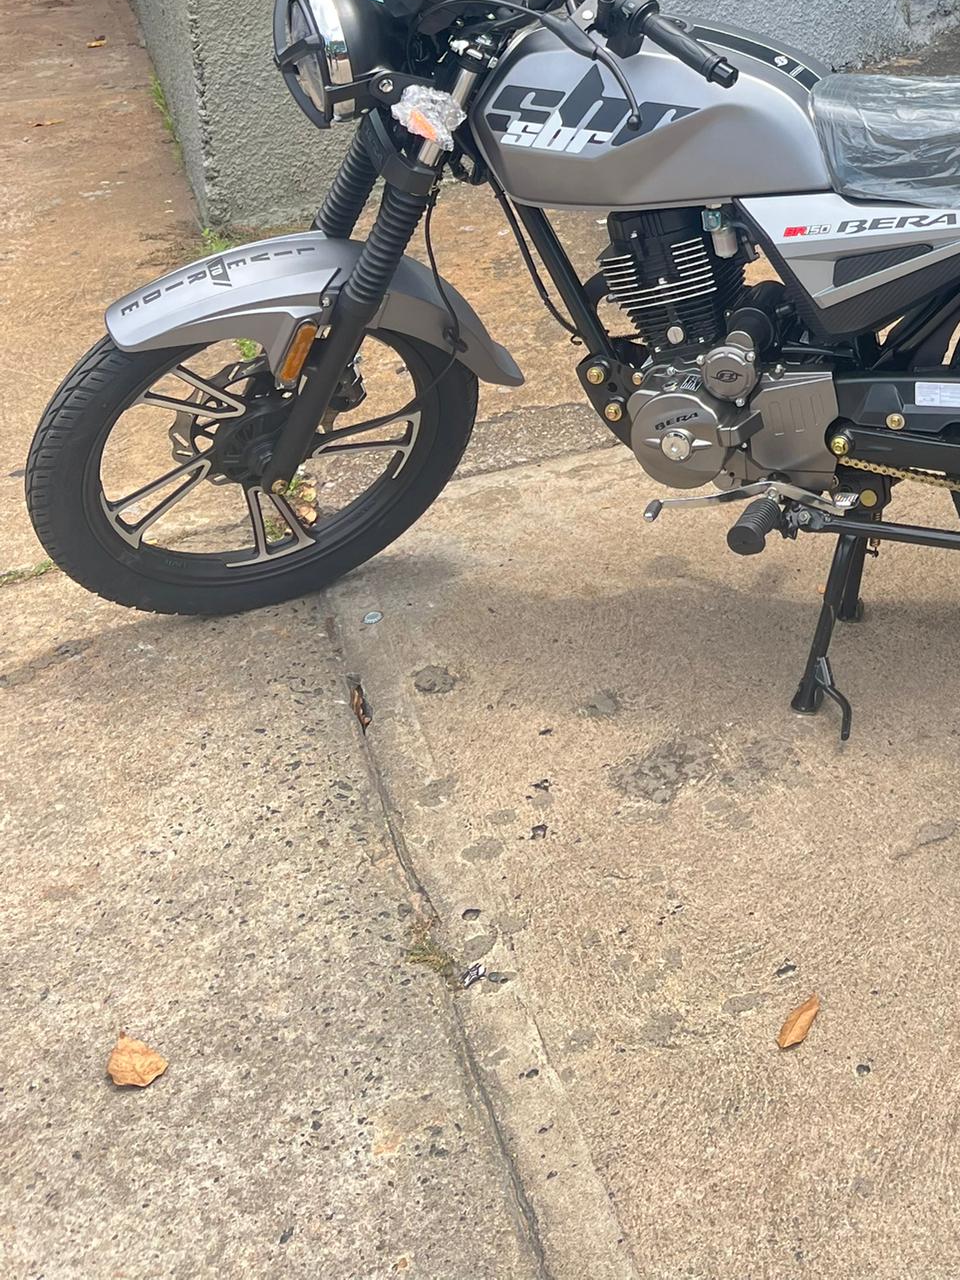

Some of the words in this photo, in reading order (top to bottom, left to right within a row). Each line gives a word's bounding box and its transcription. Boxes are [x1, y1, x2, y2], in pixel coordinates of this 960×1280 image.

[836, 213, 957, 234] BERA
[227, 247, 315, 269] LIVE
[121, 270, 207, 317] RIDE
[655, 412, 698, 431] BERA
